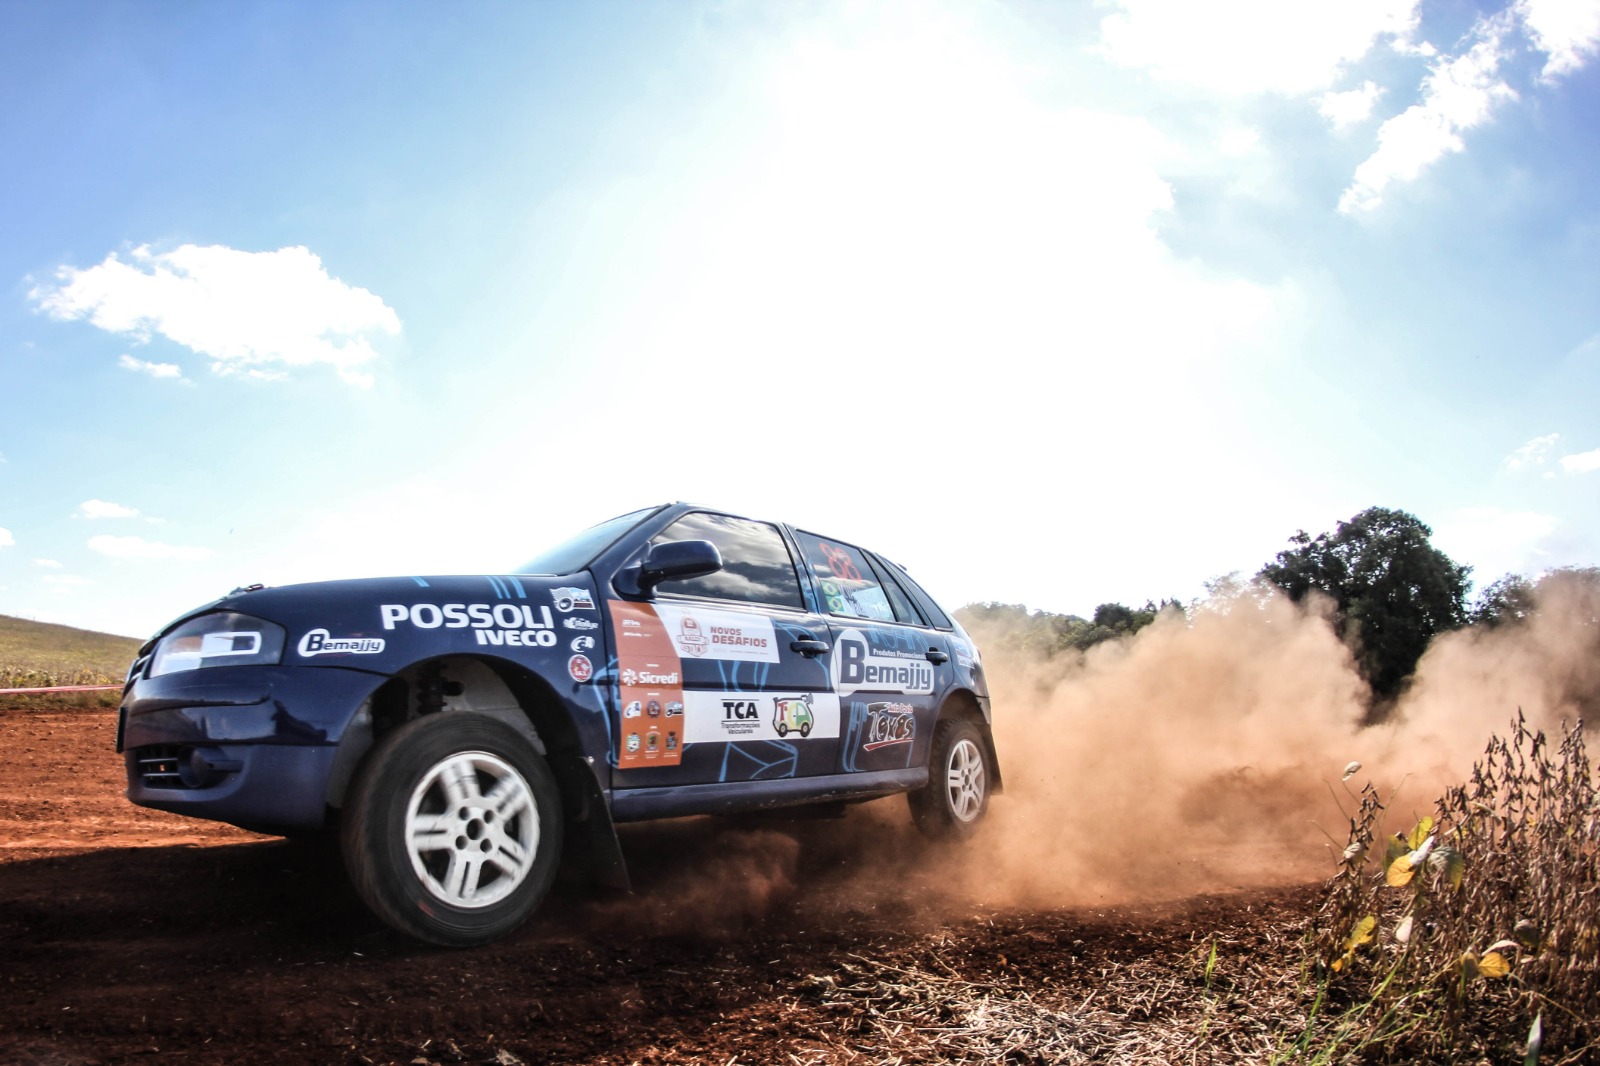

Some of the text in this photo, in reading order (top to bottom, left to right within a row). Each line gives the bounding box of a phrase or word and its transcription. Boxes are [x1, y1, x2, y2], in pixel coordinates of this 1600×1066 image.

[380, 603, 555, 630] POSSOLI
[475, 630, 557, 647] IVECO
[710, 626, 741, 636] NOVOS
[306, 633, 381, 652] Bemajjy
[712, 635, 767, 648] DESAFIOS
[872, 648, 896, 657] Produtos
[840, 638, 931, 690] Bemajjy
[638, 672, 678, 684] Sicredi
[723, 702, 759, 720] TCA
